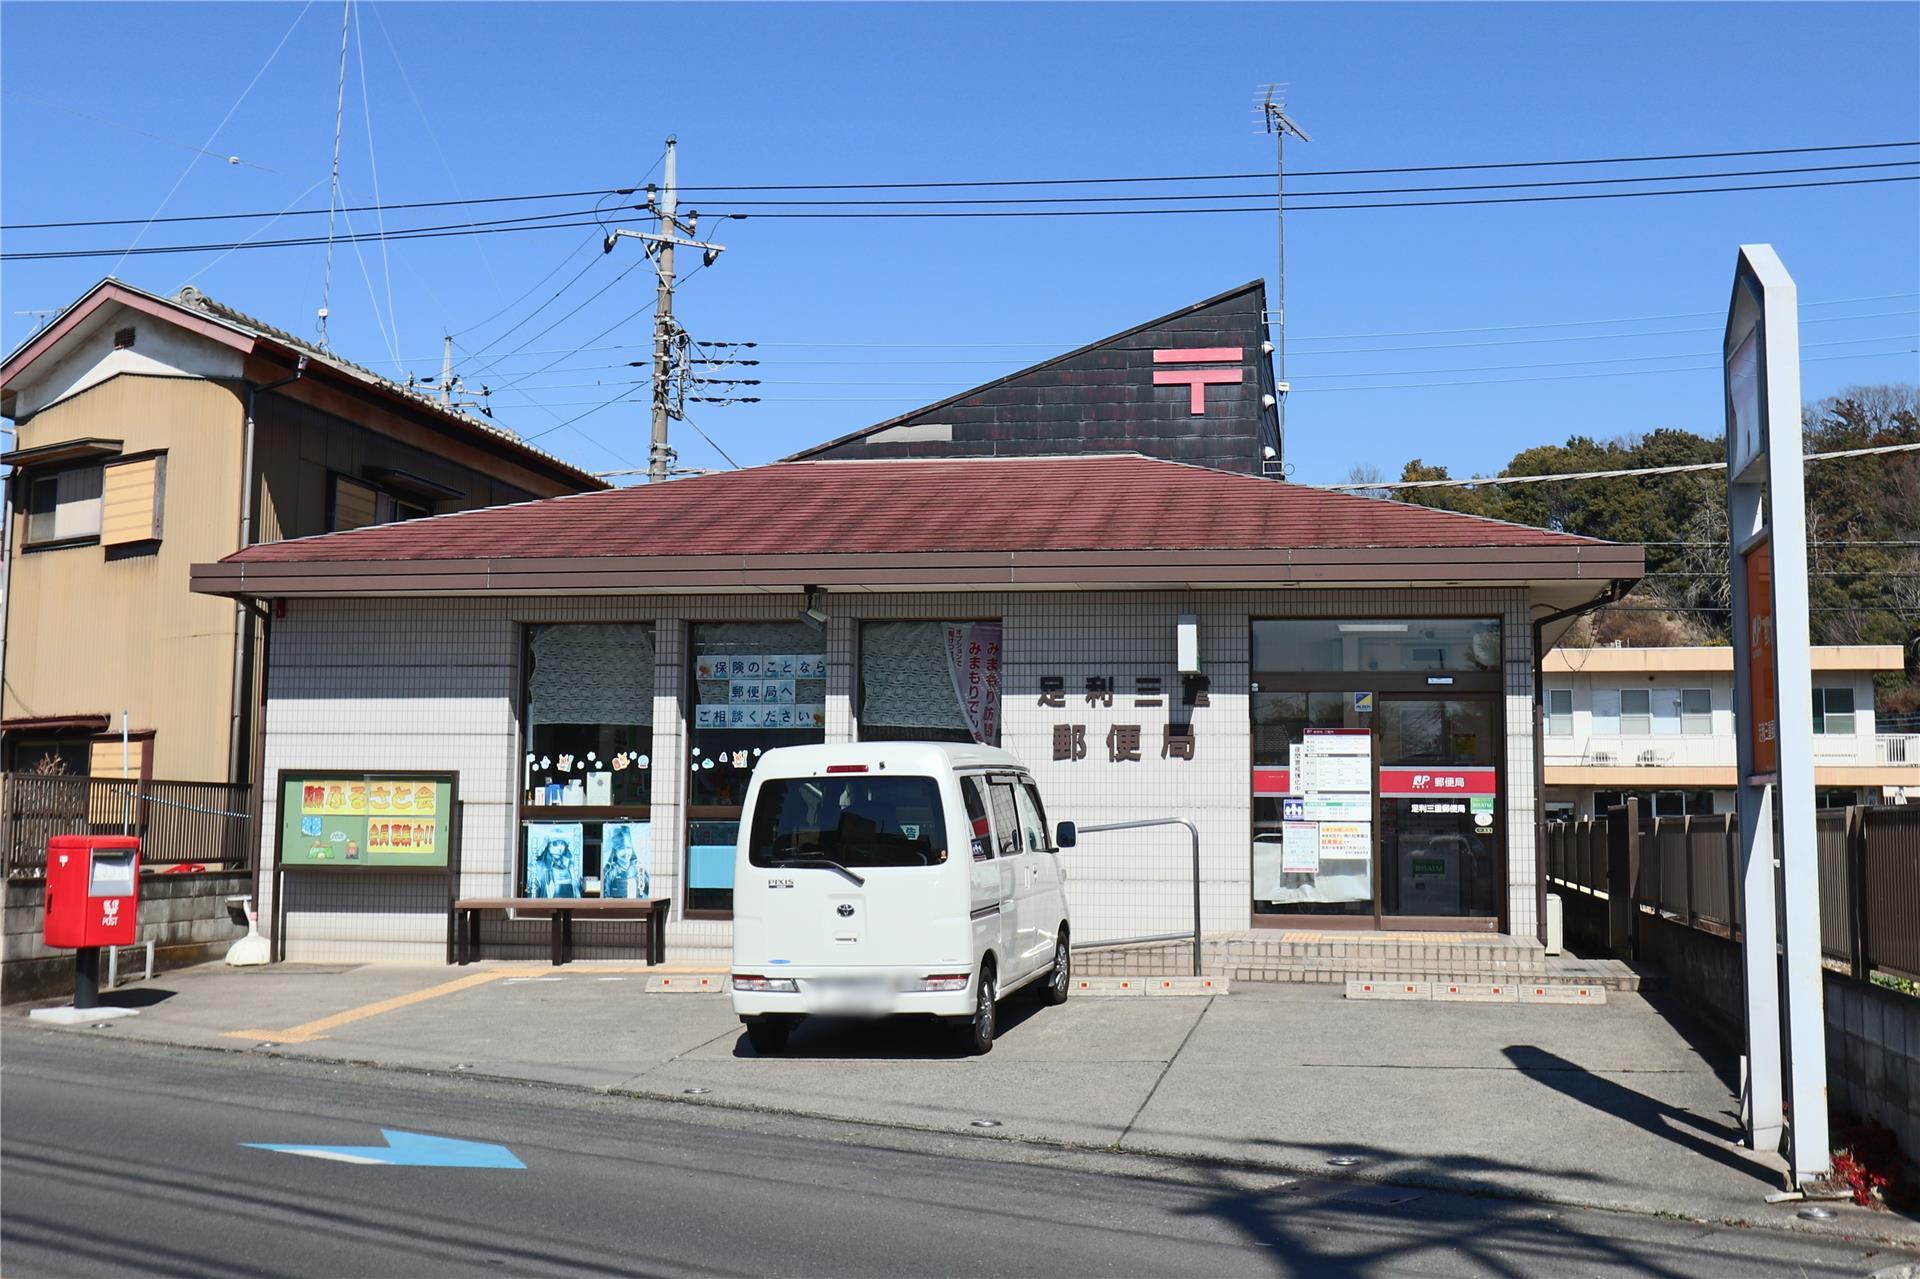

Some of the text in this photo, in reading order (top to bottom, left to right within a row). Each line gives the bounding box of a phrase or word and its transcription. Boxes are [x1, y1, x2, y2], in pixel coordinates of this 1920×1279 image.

[714, 662, 826, 674] 保険のことなら
[731, 686, 793, 699] 郵便局へ
[1037, 676, 1211, 708] 足利三重
[699, 709, 811, 723] ご相談ください
[1052, 723, 1196, 762] 郵便局
[1434, 777, 1465, 788] 郵便局
[101, 916, 118, 927] POST
